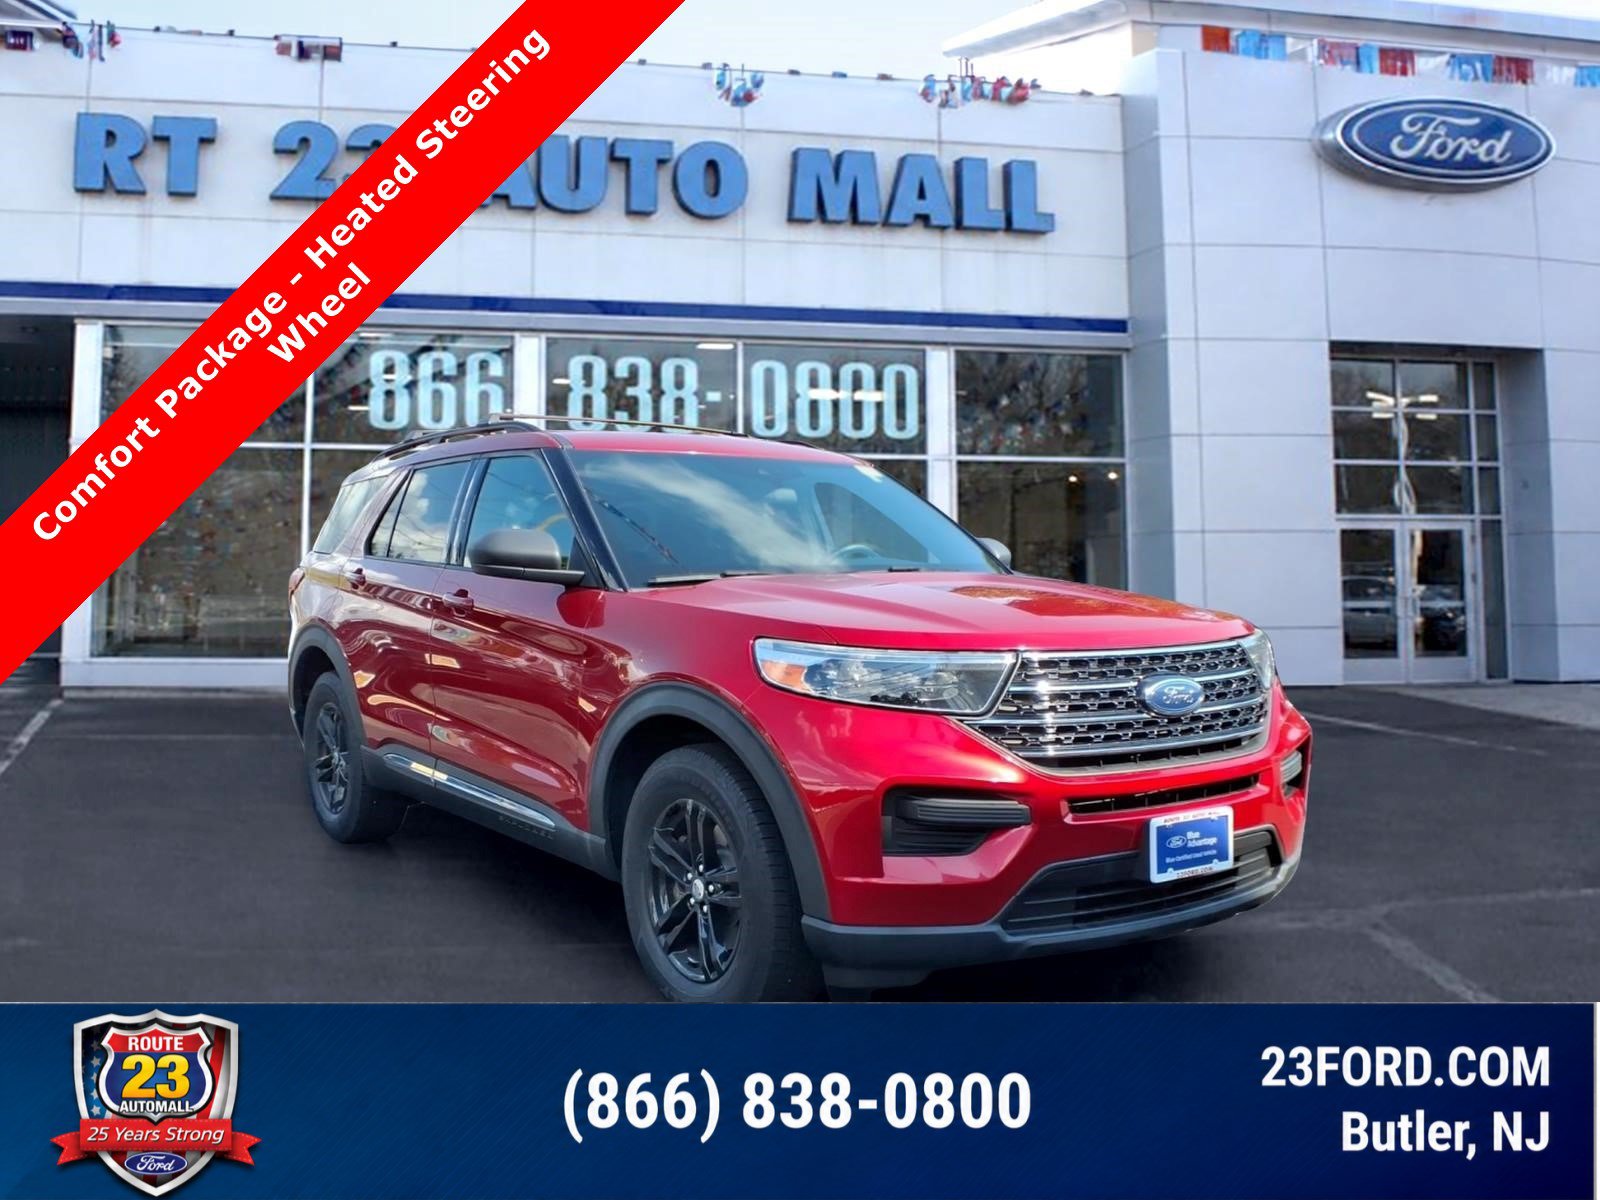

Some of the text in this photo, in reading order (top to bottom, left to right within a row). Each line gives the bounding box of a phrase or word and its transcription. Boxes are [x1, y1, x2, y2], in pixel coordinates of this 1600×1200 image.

[1389, 111, 1513, 163] Ford
[73, 111, 218, 197] RT
[787, 147, 1056, 235] MALL
[368, 350, 505, 430] 866
[1163, 686, 1195, 705] Ford
